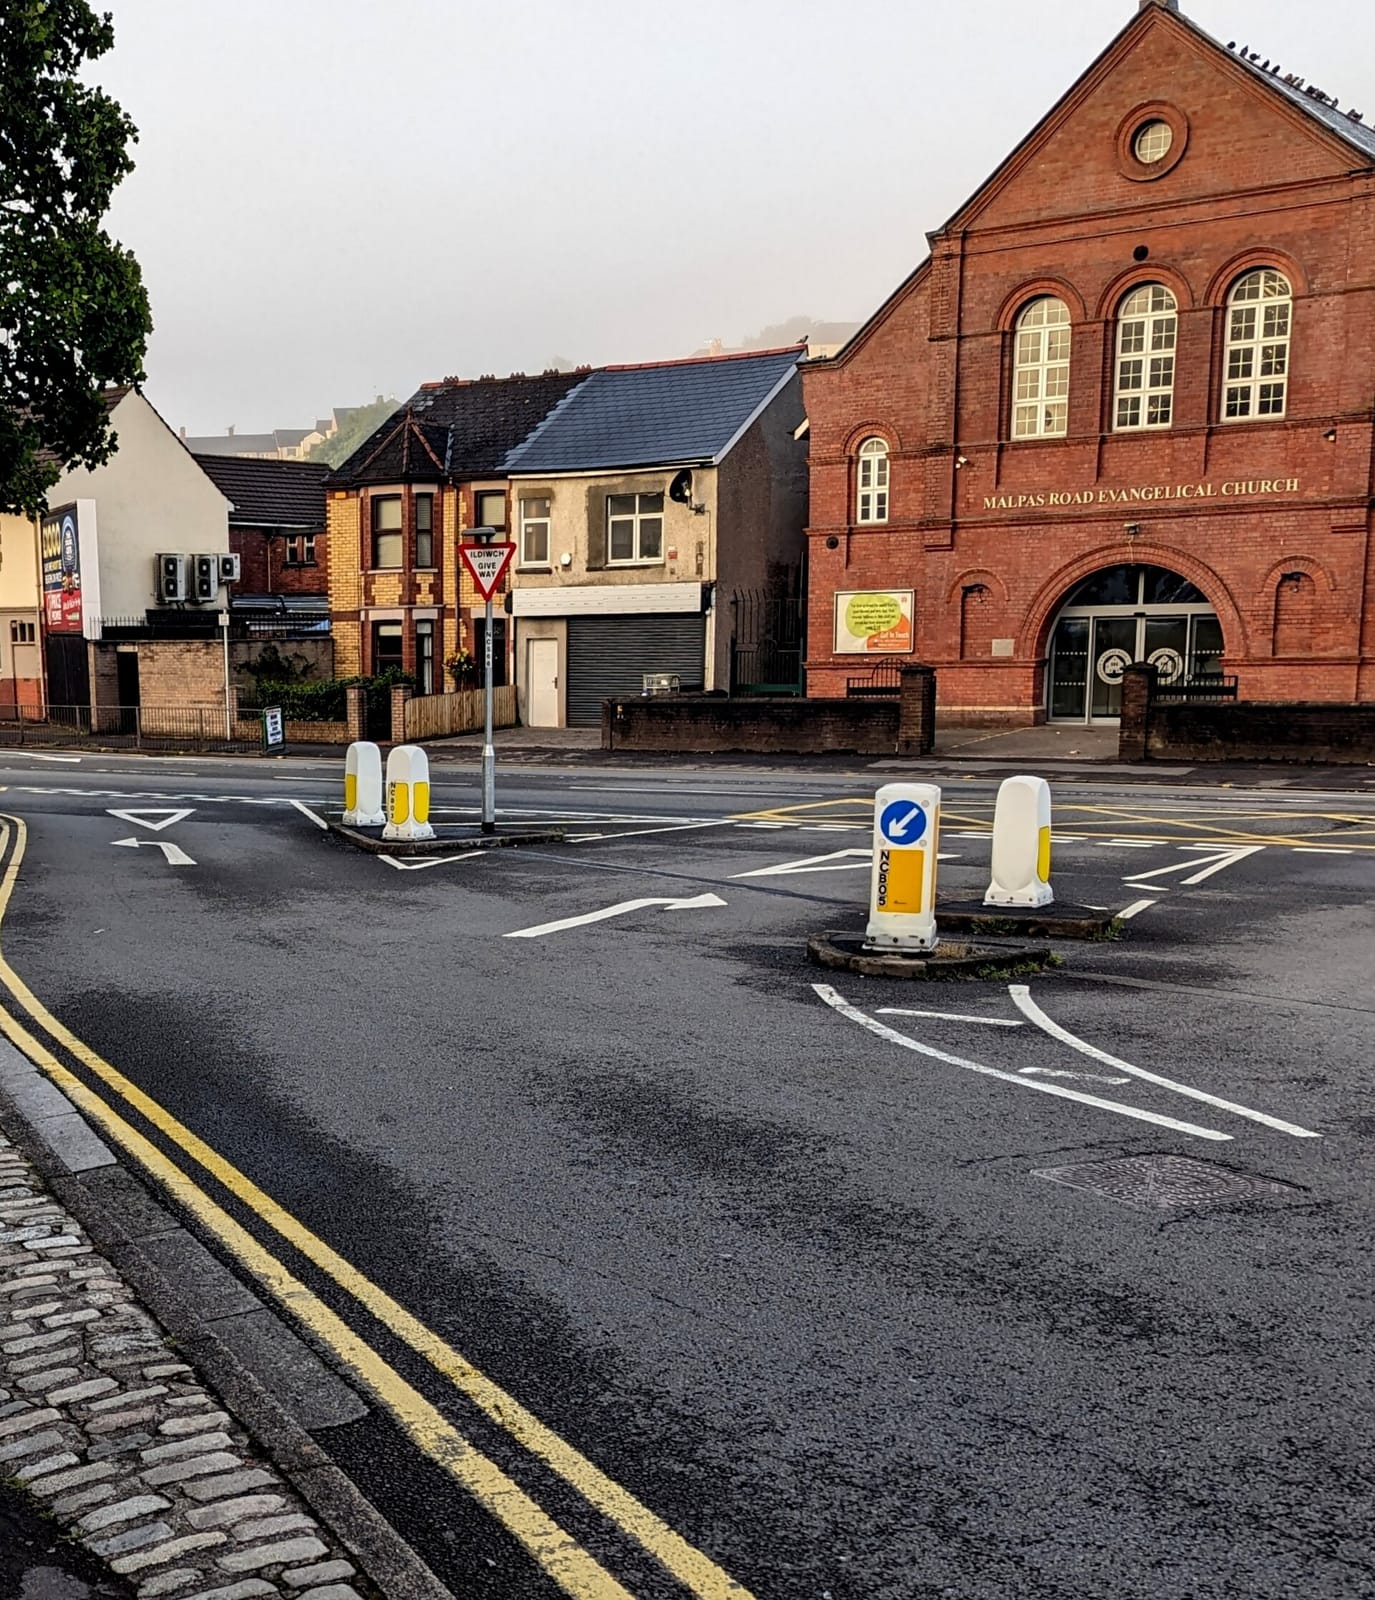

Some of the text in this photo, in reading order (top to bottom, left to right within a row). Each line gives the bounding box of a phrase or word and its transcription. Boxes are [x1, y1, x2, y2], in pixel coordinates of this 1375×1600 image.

[983, 478, 1299, 510] MALPAS ROAD EVANGELICAL CHURCH
[470, 550, 505, 558] ILDIWCH
[478, 562, 496, 570] GIVE
[878, 850, 890, 906] NCB05
